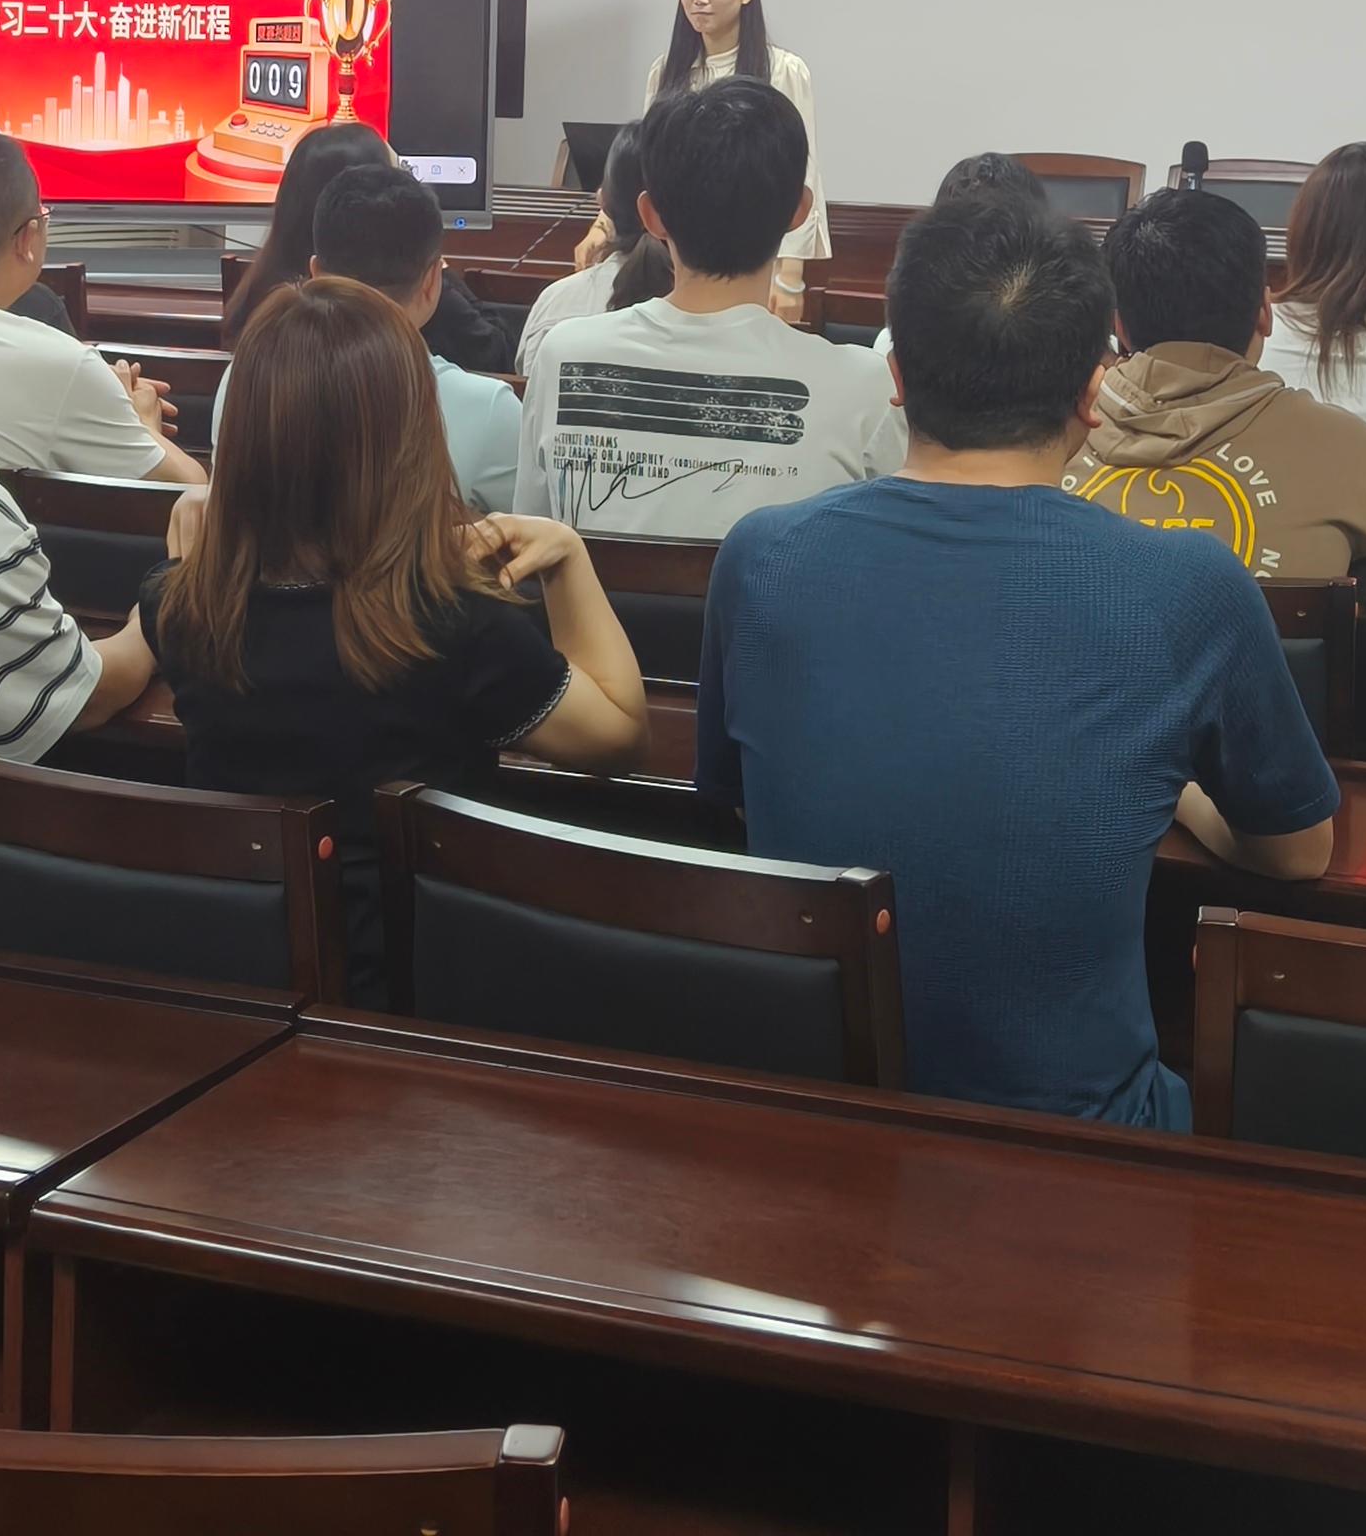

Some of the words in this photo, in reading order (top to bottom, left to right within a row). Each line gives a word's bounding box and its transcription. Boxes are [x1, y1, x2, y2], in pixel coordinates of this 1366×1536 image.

[248, 60, 303, 100] 009
[648, 466, 670, 480] LAND
[1215, 441, 1277, 508] LOVE
